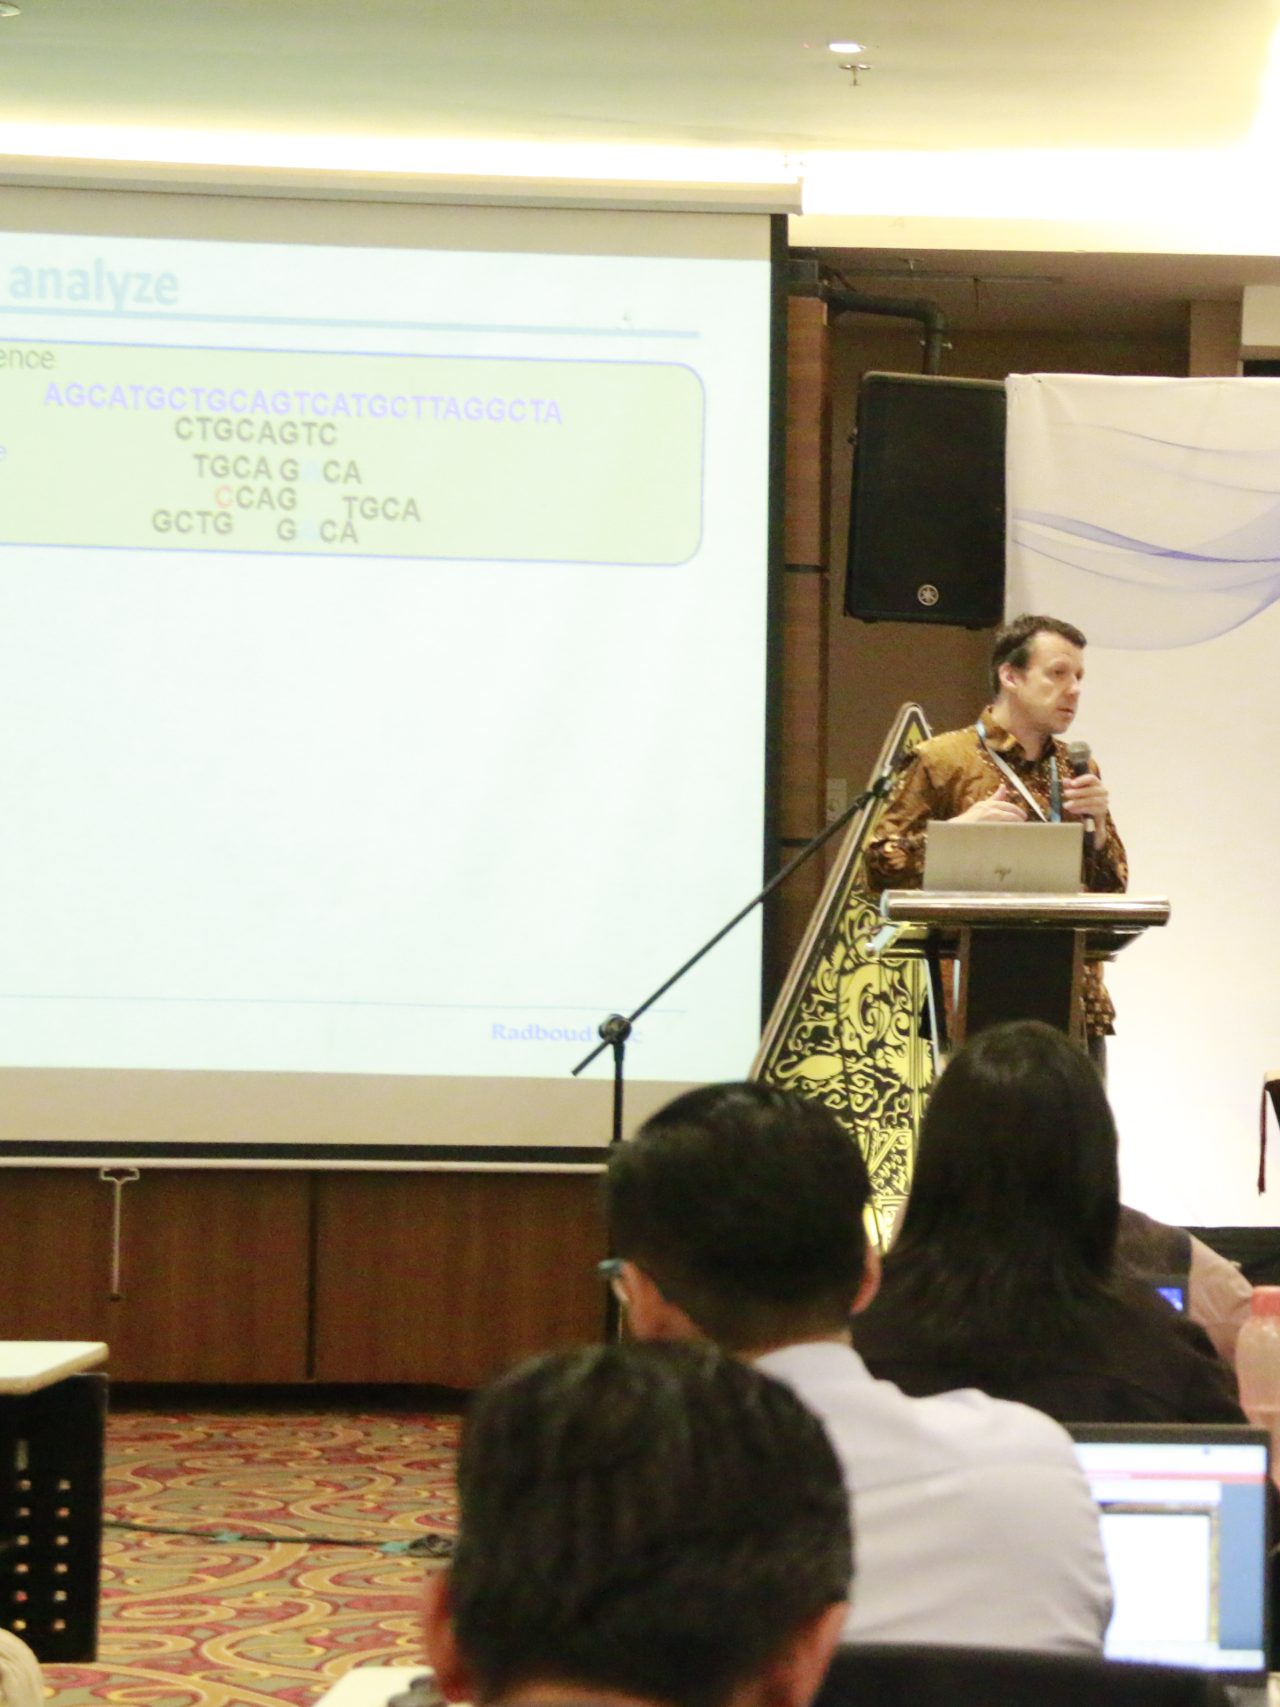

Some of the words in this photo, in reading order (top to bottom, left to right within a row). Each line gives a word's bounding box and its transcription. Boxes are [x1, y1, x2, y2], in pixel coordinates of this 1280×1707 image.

[8, 258, 180, 311] analyze
[174, 415, 336, 446] CTGCAGTC
[151, 508, 233, 535] GCTG
[342, 494, 421, 523] TGCA
[491, 1023, 644, 1044] Radboudc
